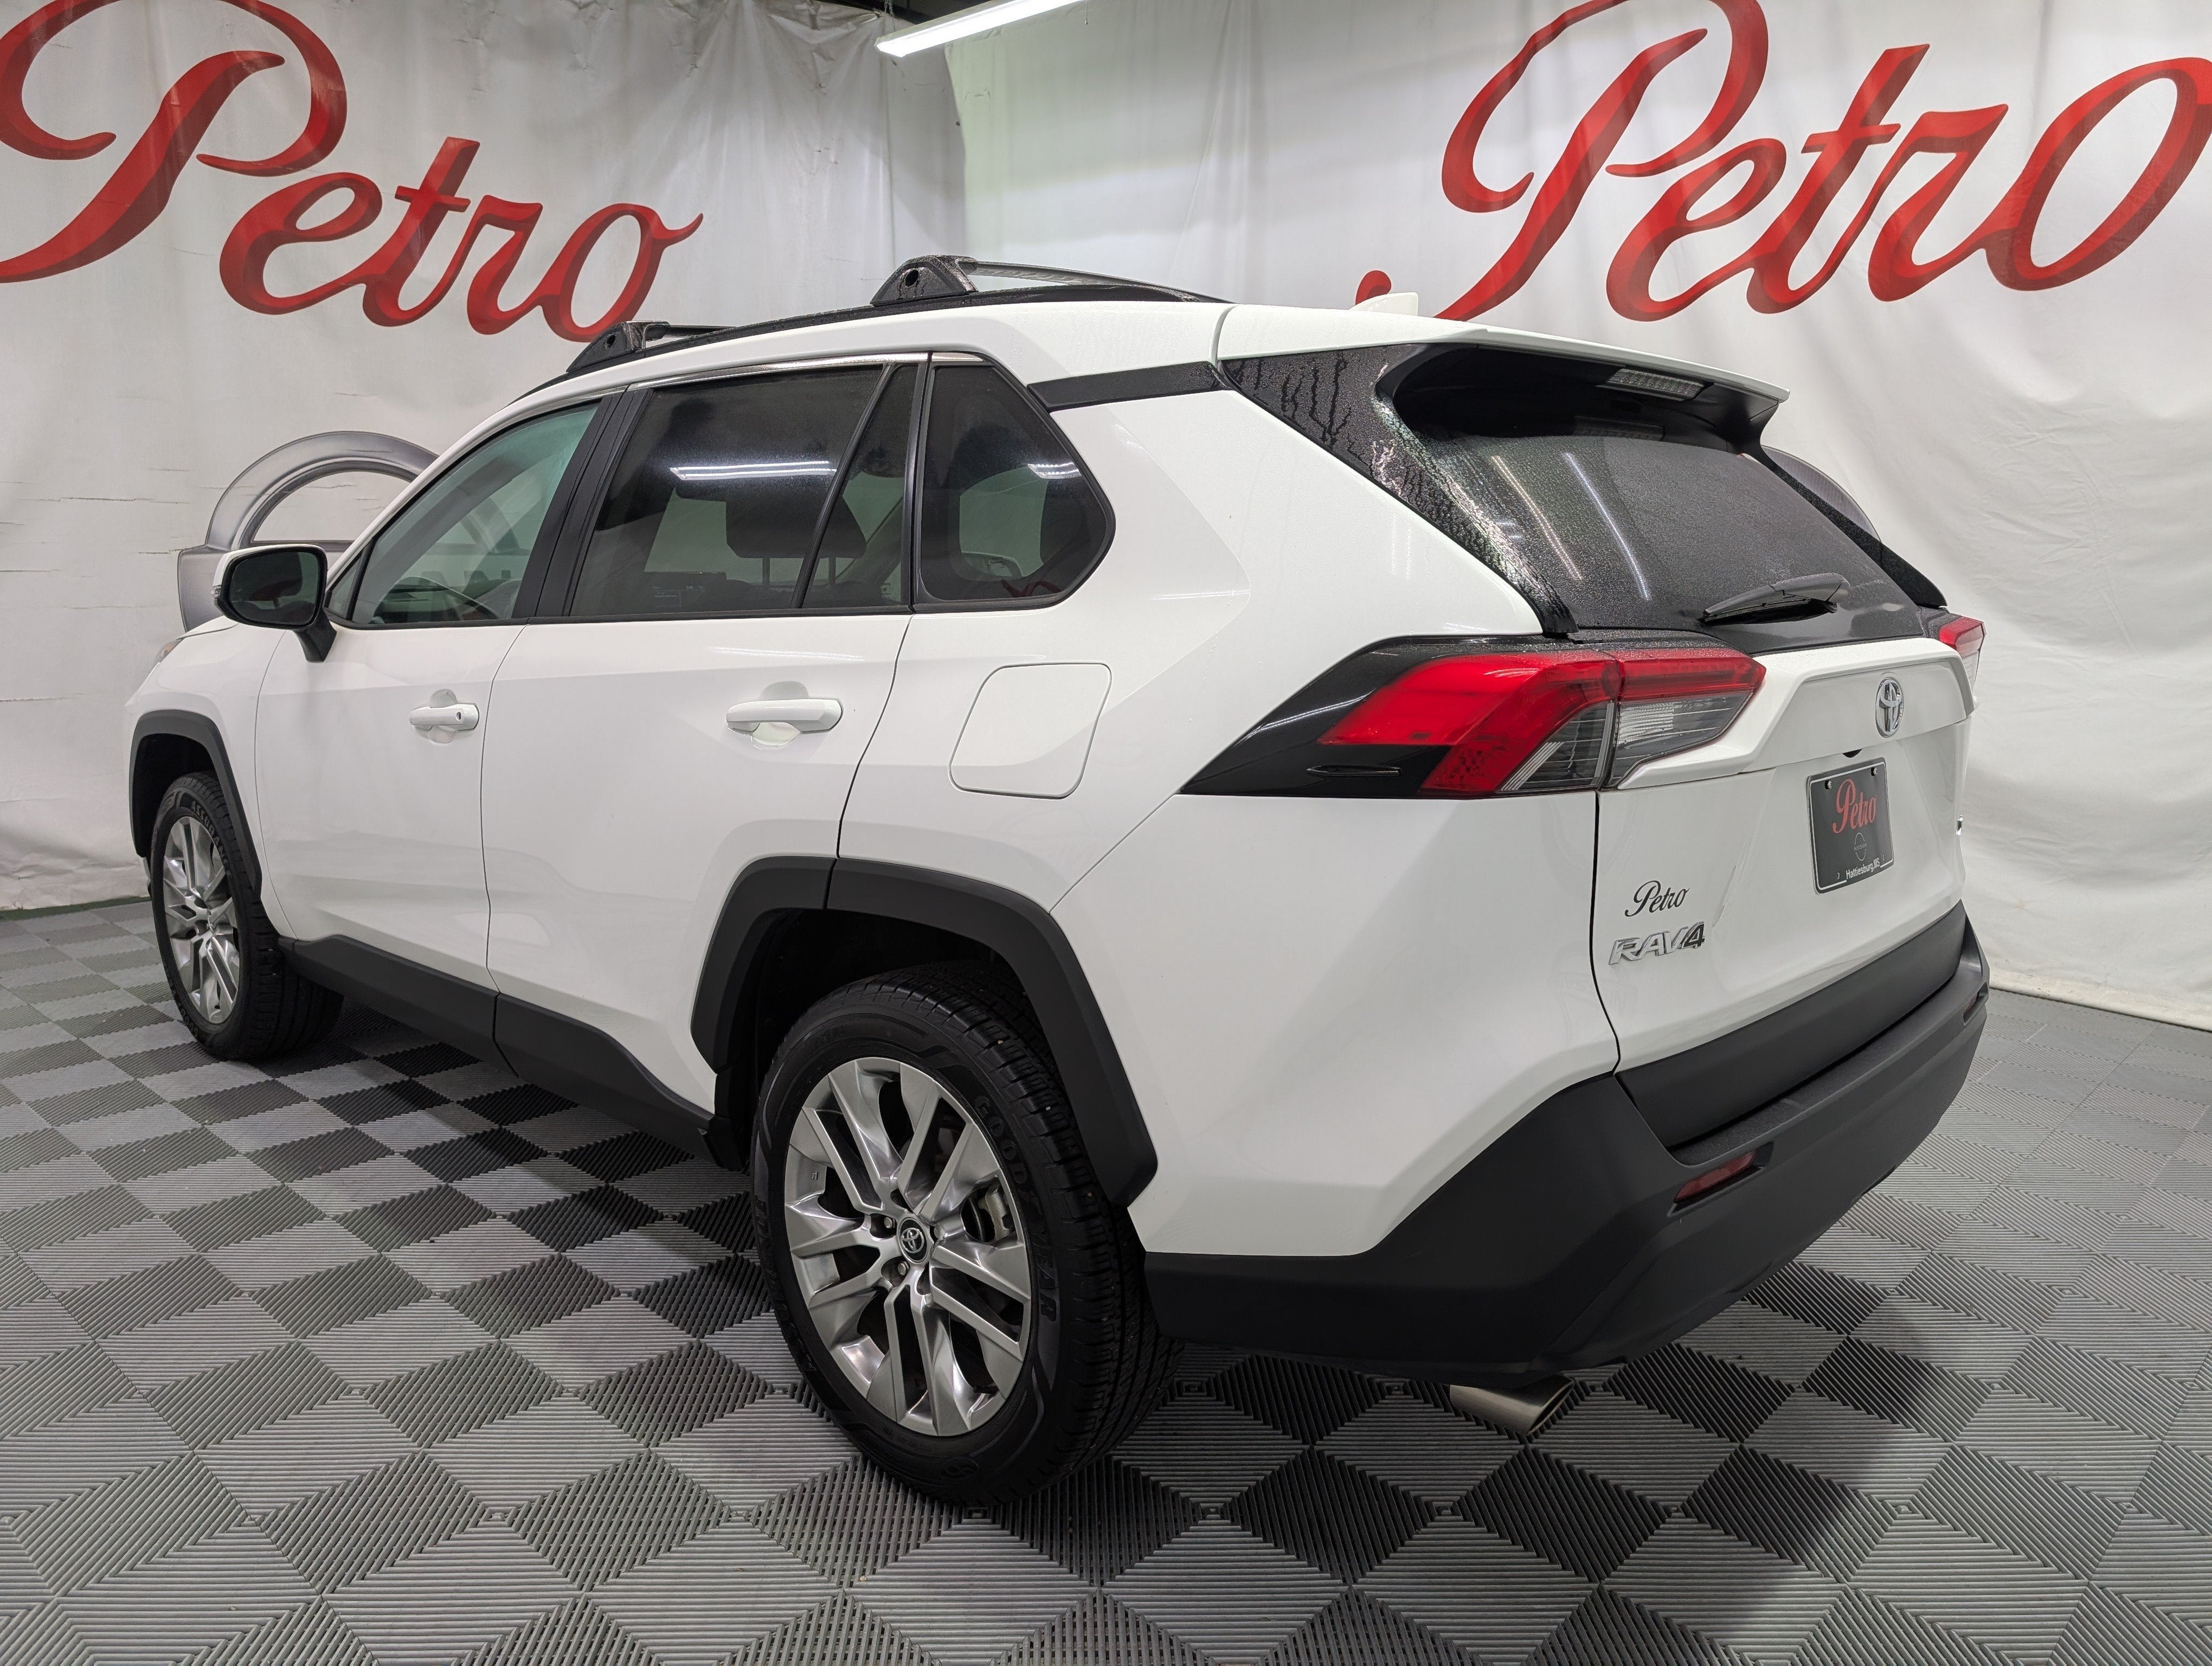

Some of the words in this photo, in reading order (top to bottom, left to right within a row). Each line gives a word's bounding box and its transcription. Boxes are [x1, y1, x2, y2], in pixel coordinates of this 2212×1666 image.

[0, 0, 704, 342] Petro
[1356, 0, 2212, 322] Petro
[1832, 779, 1877, 834] Petro
[1854, 843, 1867, 851] NISSAN
[1625, 880, 1690, 917] Petro
[1609, 921, 1705, 965] RAV4
